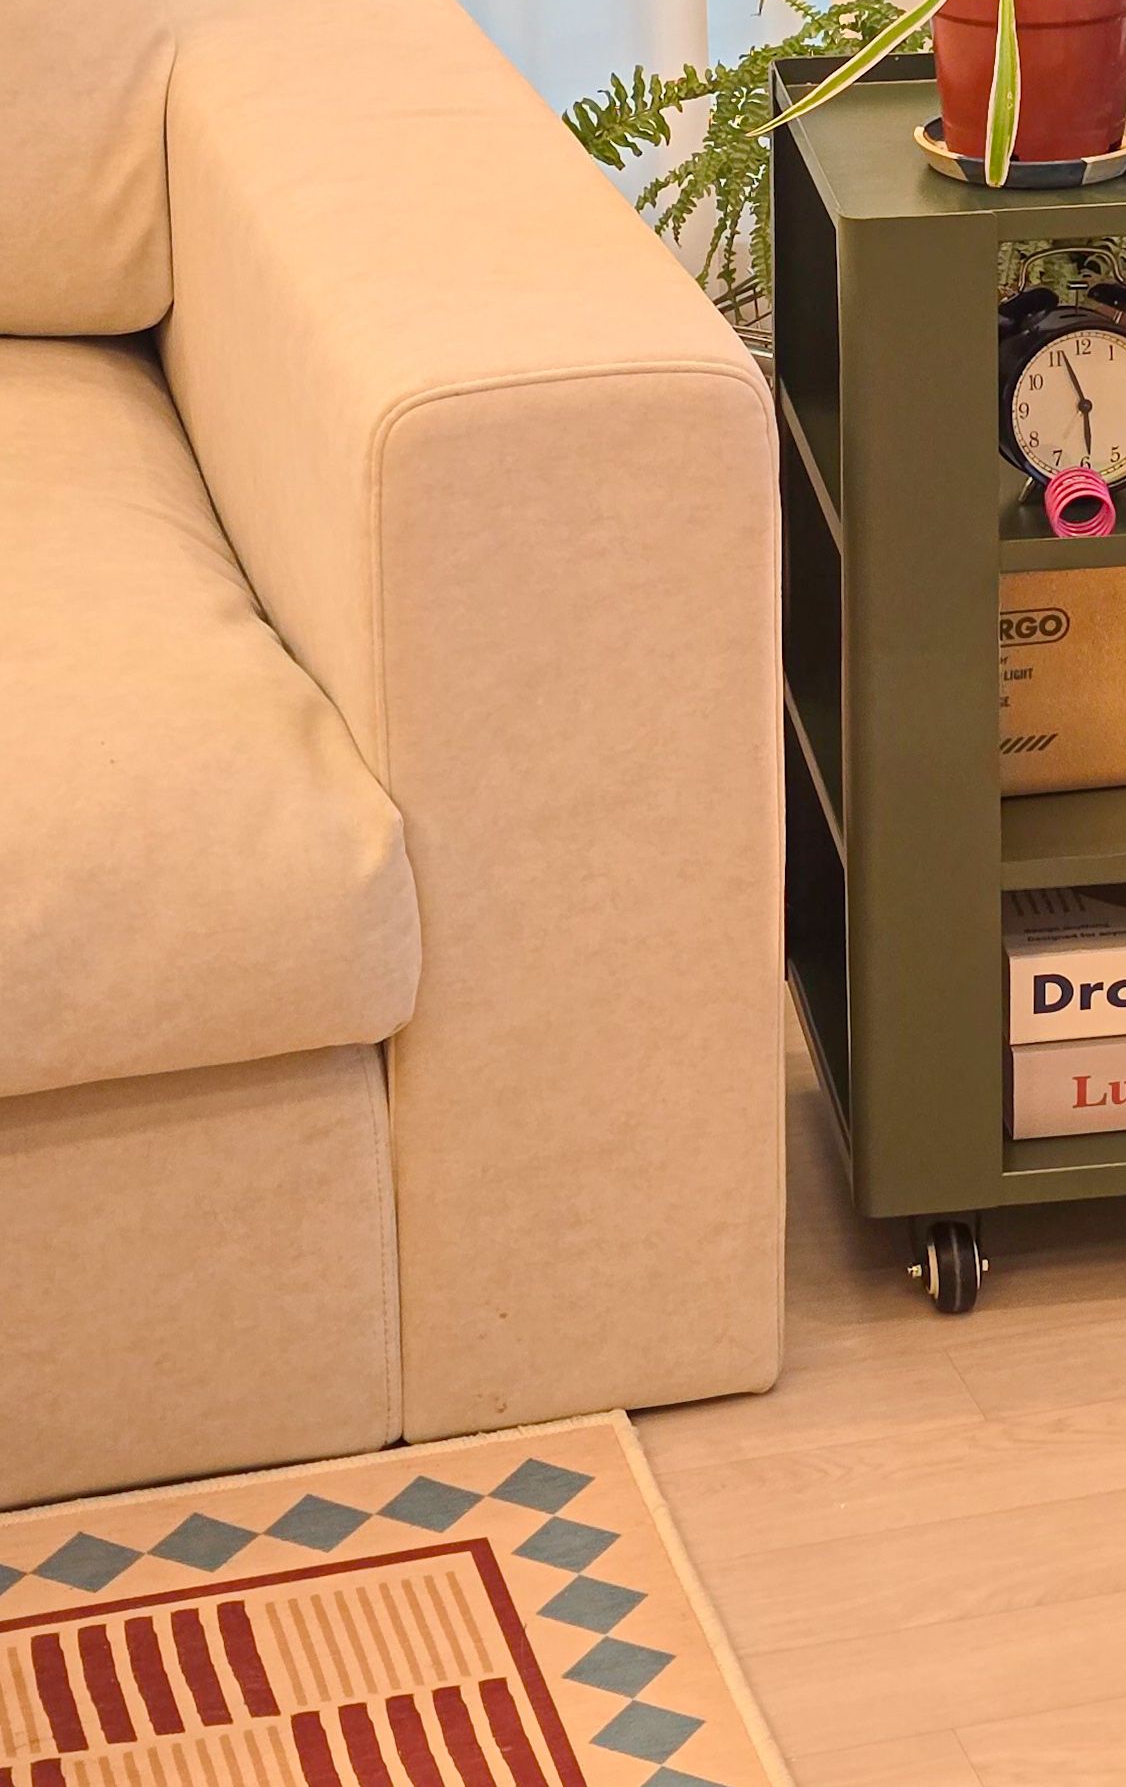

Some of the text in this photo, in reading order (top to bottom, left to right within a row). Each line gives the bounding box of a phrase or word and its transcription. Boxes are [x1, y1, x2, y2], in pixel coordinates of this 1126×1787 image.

[1075, 339, 1091, 356] 12
[1108, 345, 1114, 360] 1
[1048, 351, 1063, 367] 11
[1029, 374, 1043, 391] 10
[1018, 402, 1030, 419] 9
[1029, 431, 1039, 448] 8
[1053, 449, 1063, 466] 7
[1080, 456, 1091, 469] 6
[1110, 446, 1120, 463] 5
